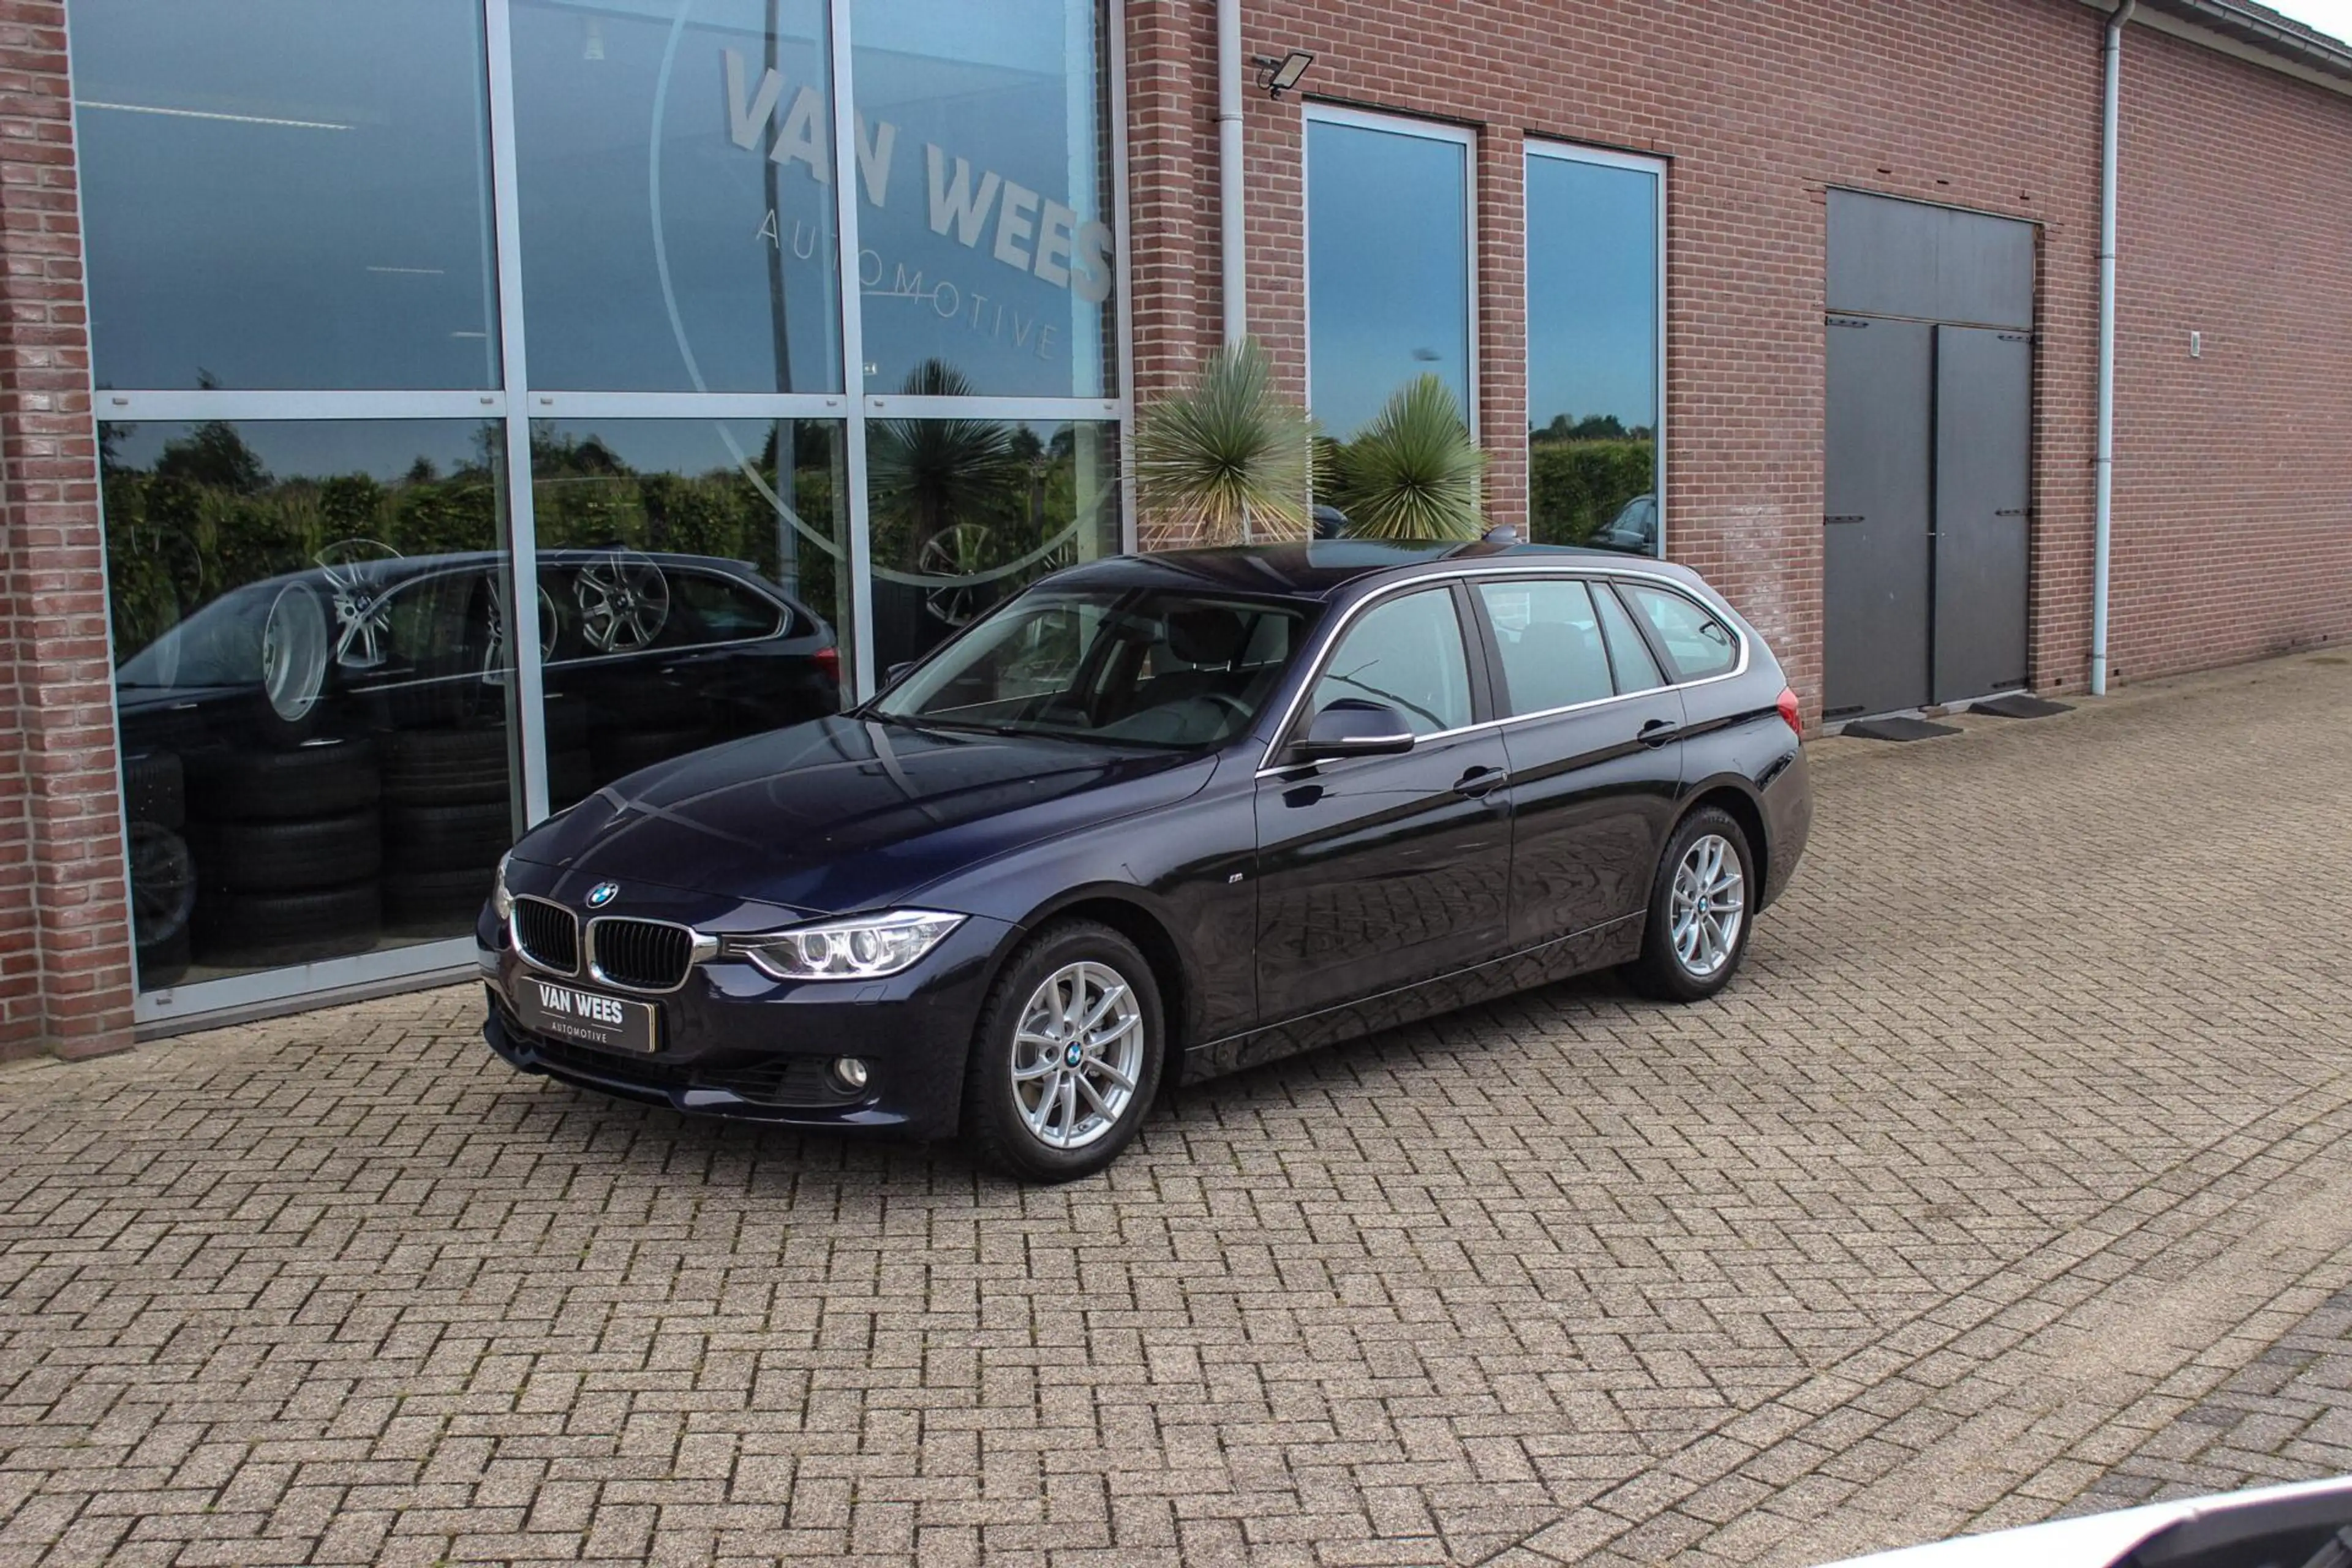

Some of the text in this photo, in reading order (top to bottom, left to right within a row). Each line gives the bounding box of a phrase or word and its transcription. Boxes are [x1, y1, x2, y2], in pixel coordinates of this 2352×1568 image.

[724, 48, 1114, 303] VAN WEES
[539, 984, 623, 1024] VAN WEES
[552, 1022, 608, 1044] AUTOMOTIVE
